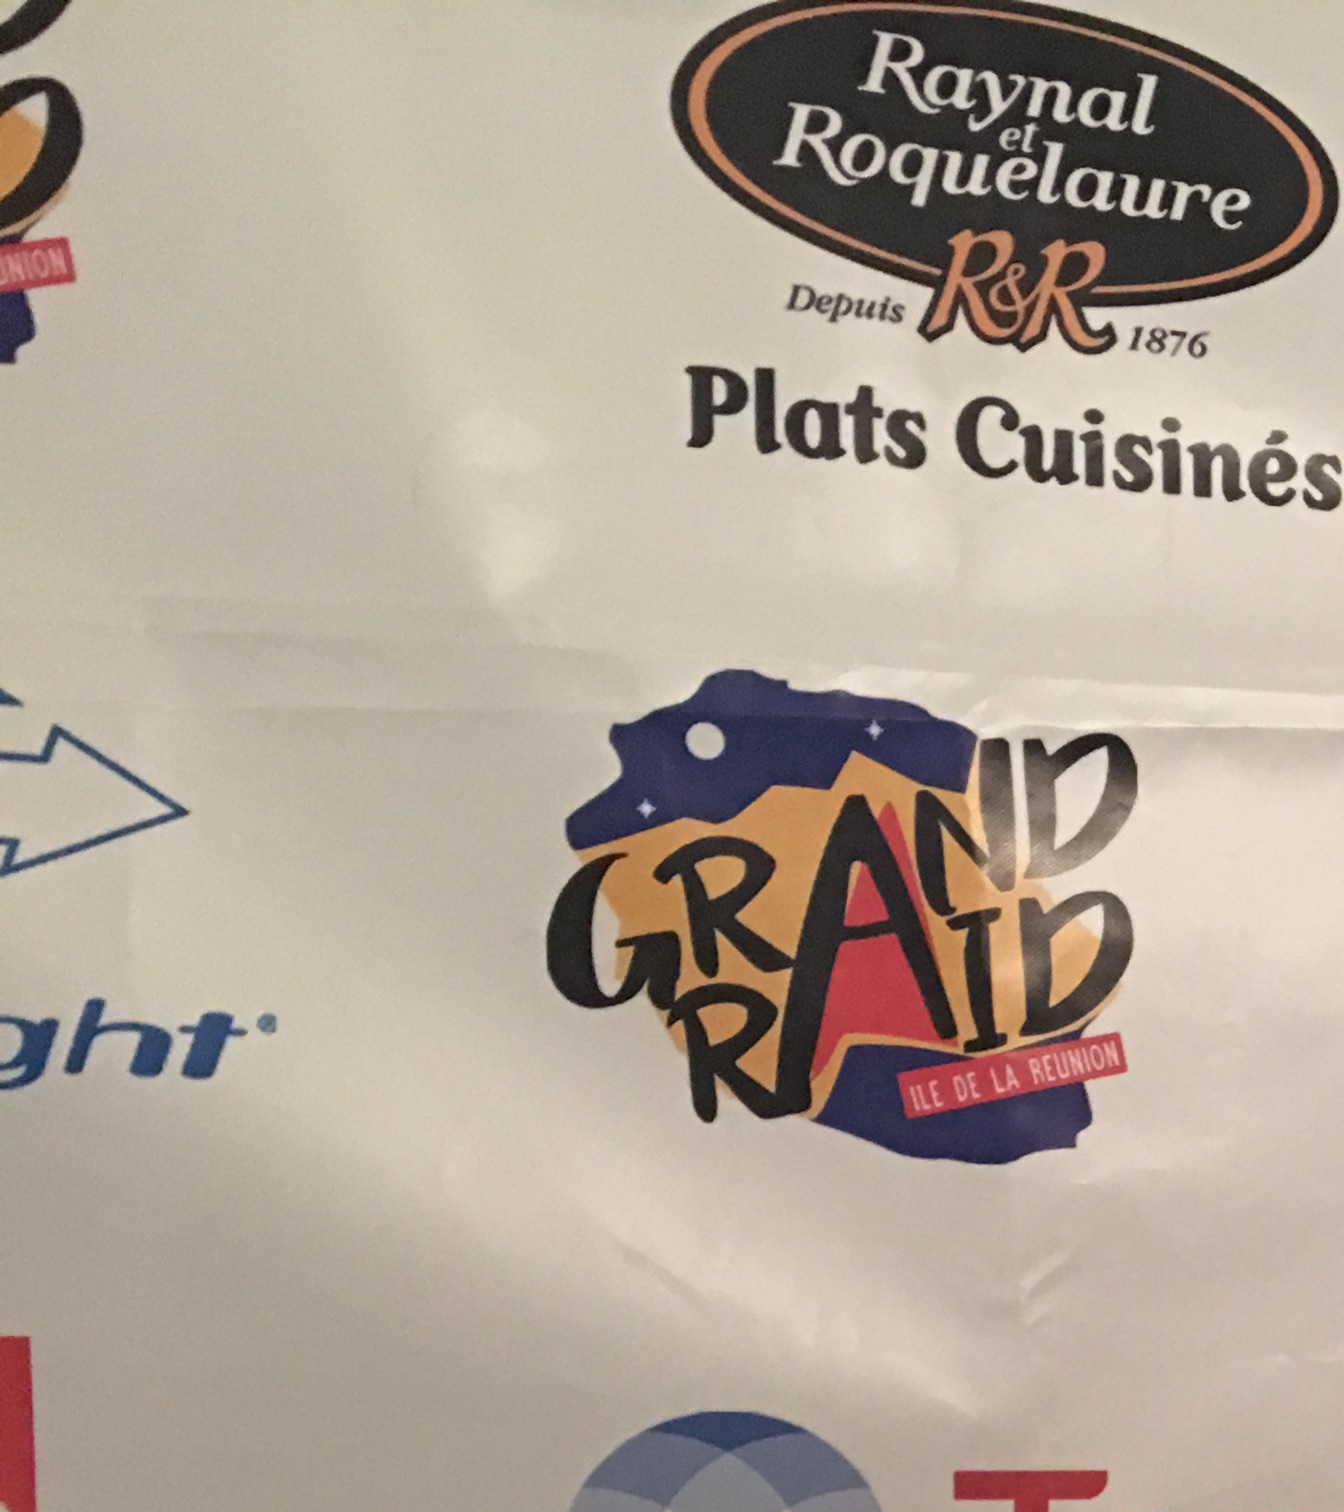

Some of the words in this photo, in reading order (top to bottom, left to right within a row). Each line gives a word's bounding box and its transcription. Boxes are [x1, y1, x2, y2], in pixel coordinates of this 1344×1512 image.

[857, 30, 1159, 136] Raynal
[773, 102, 1252, 230] Roquelaure
[999, 122, 1039, 153] et
[0, 248, 68, 284] NION
[923, 228, 1112, 350] R&R
[786, 284, 905, 323] Depuis
[1128, 326, 1210, 358] 1876
[685, 366, 927, 472] Plats
[956, 395, 1343, 513] Cuisinés
[546, 732, 1138, 1010] GRAND
[909, 1080, 944, 1112] ILE
[952, 1071, 981, 1102] DE
[989, 1064, 1020, 1094] LA
[1028, 1040, 1120, 1085] REUNION
